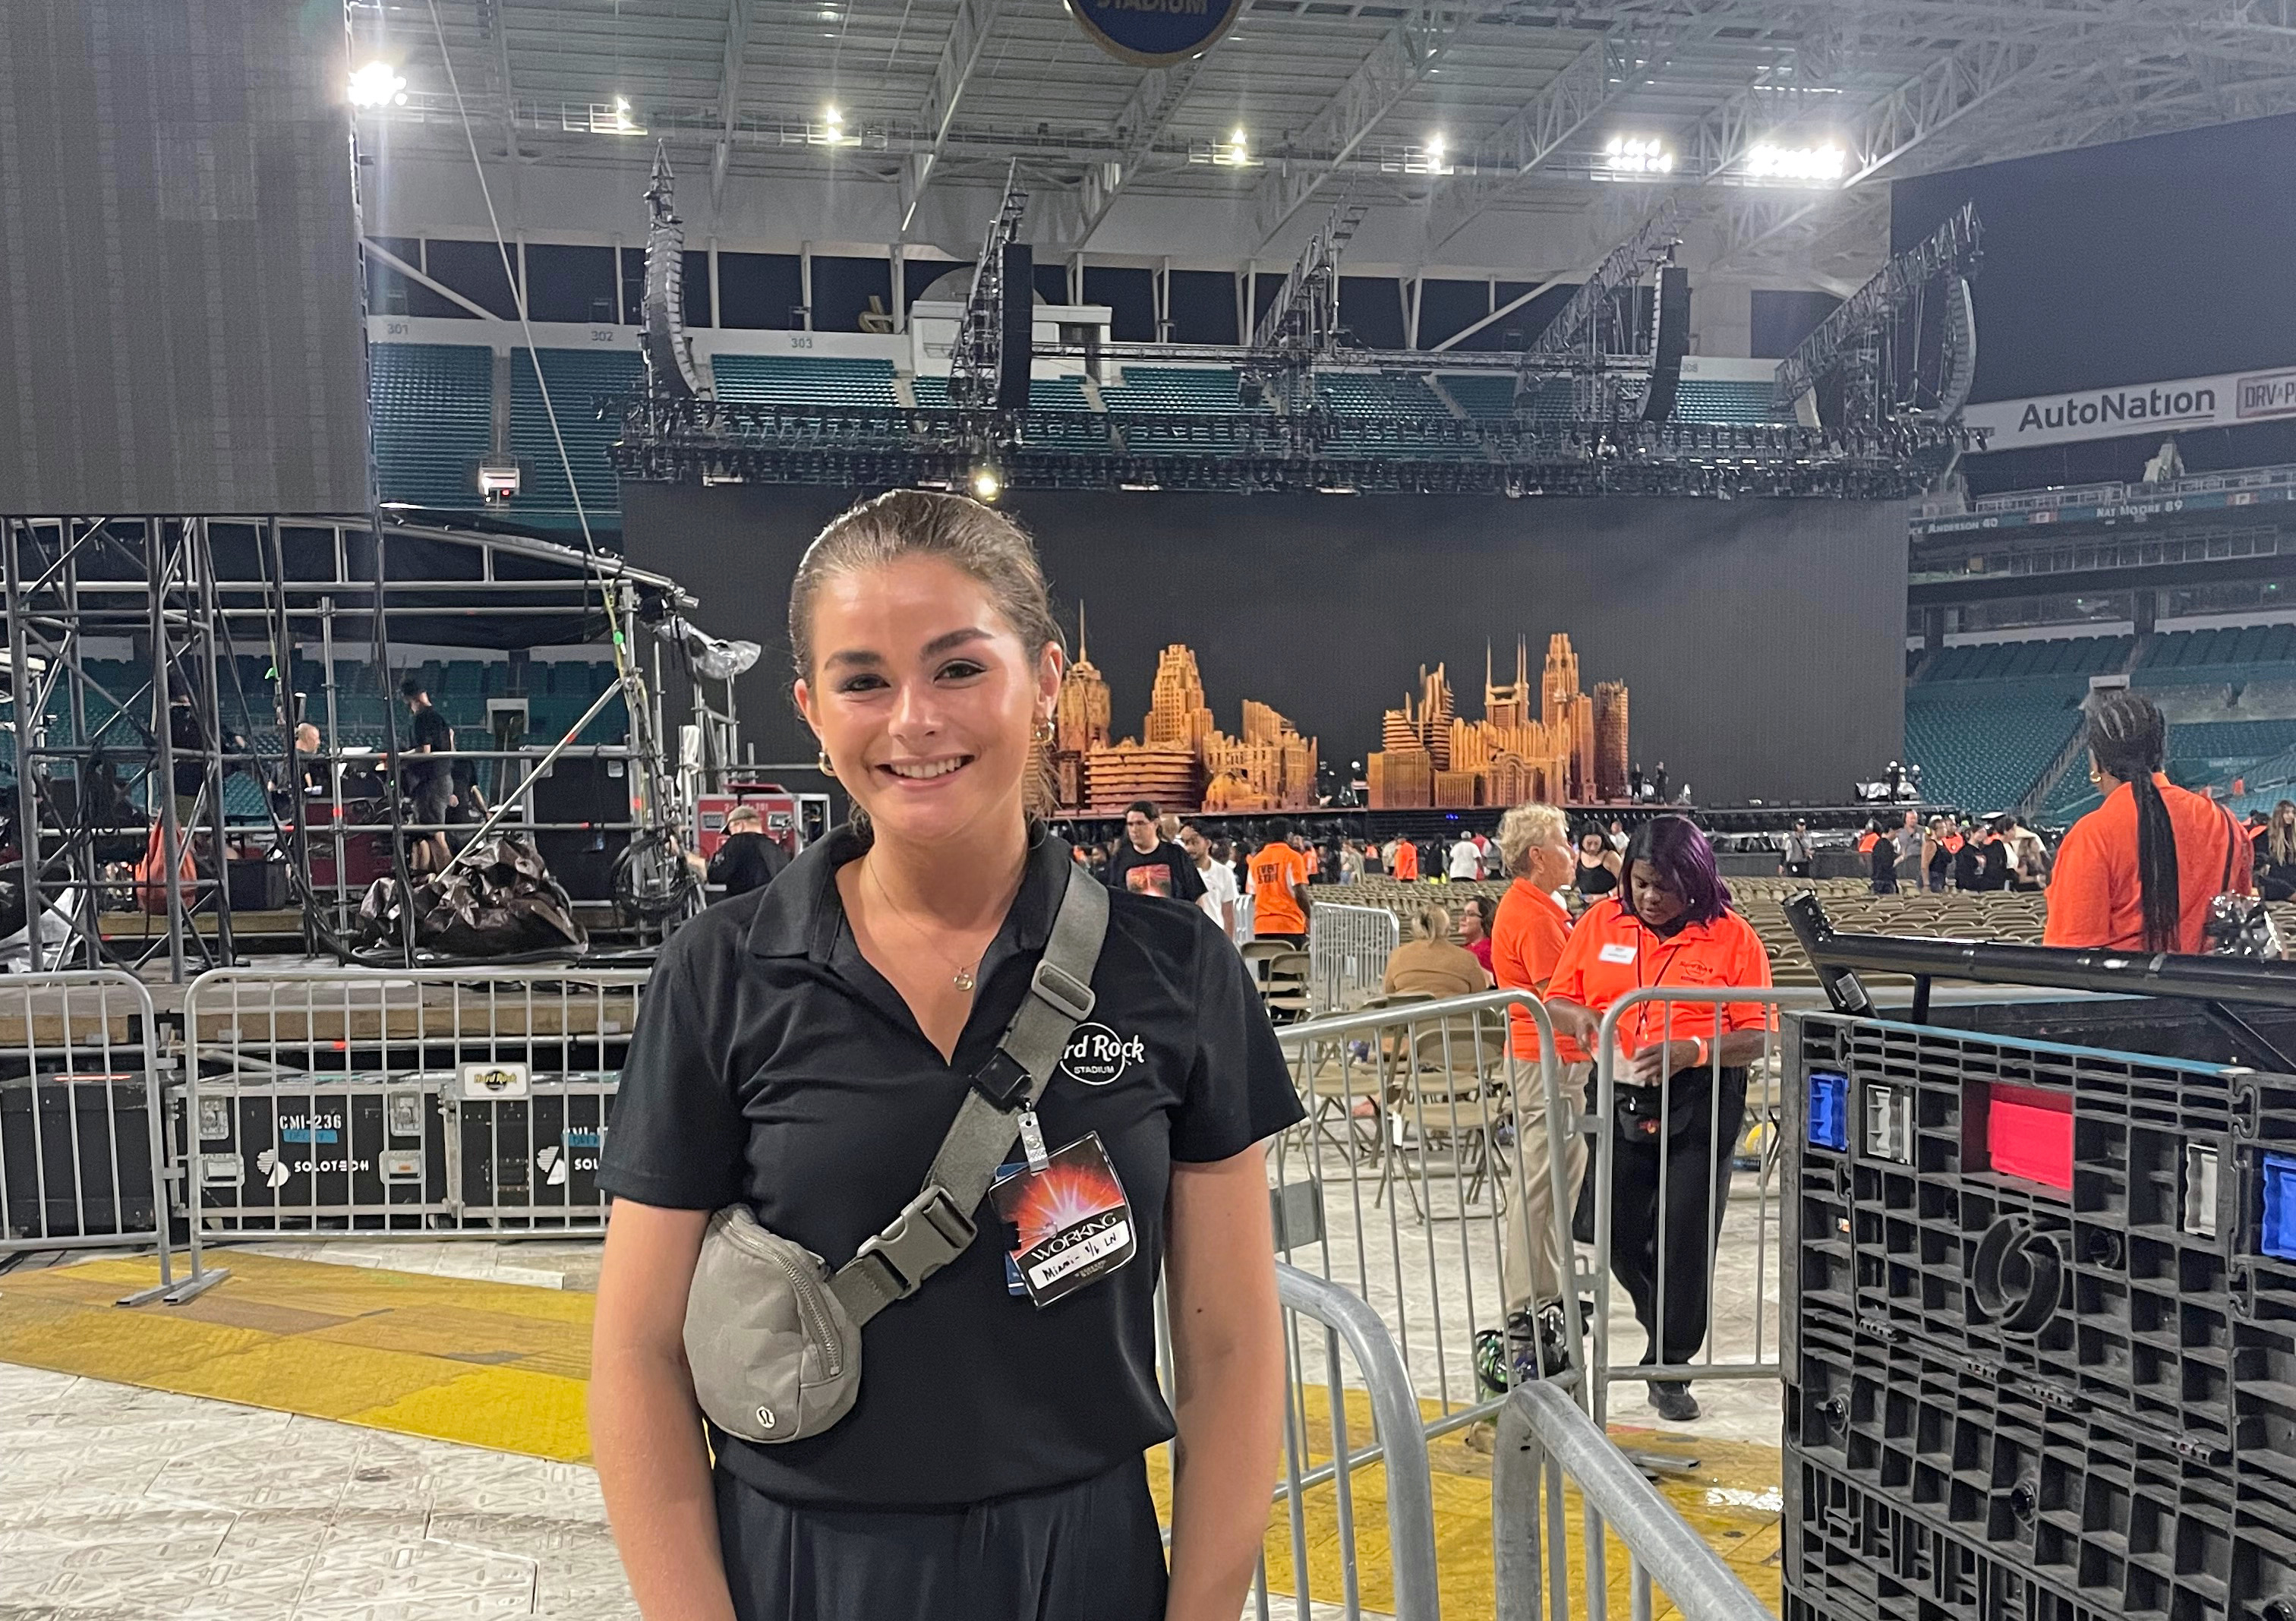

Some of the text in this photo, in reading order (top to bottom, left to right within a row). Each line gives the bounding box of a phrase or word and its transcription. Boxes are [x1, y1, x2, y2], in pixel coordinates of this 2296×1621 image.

[387, 323, 408, 335] 301
[591, 330, 613, 342] 302
[791, 338, 812, 348] 303
[2244, 384, 2276, 408] DRV
[2018, 388, 2215, 432] AutoNation
[2165, 500, 2184, 512] 89
[1063, 1034, 1145, 1063] rd Rock
[1074, 1065, 1115, 1074] STADIUM
[474, 1072, 517, 1084] Hard Rock
[1031, 1213, 1116, 1260] WORKING
